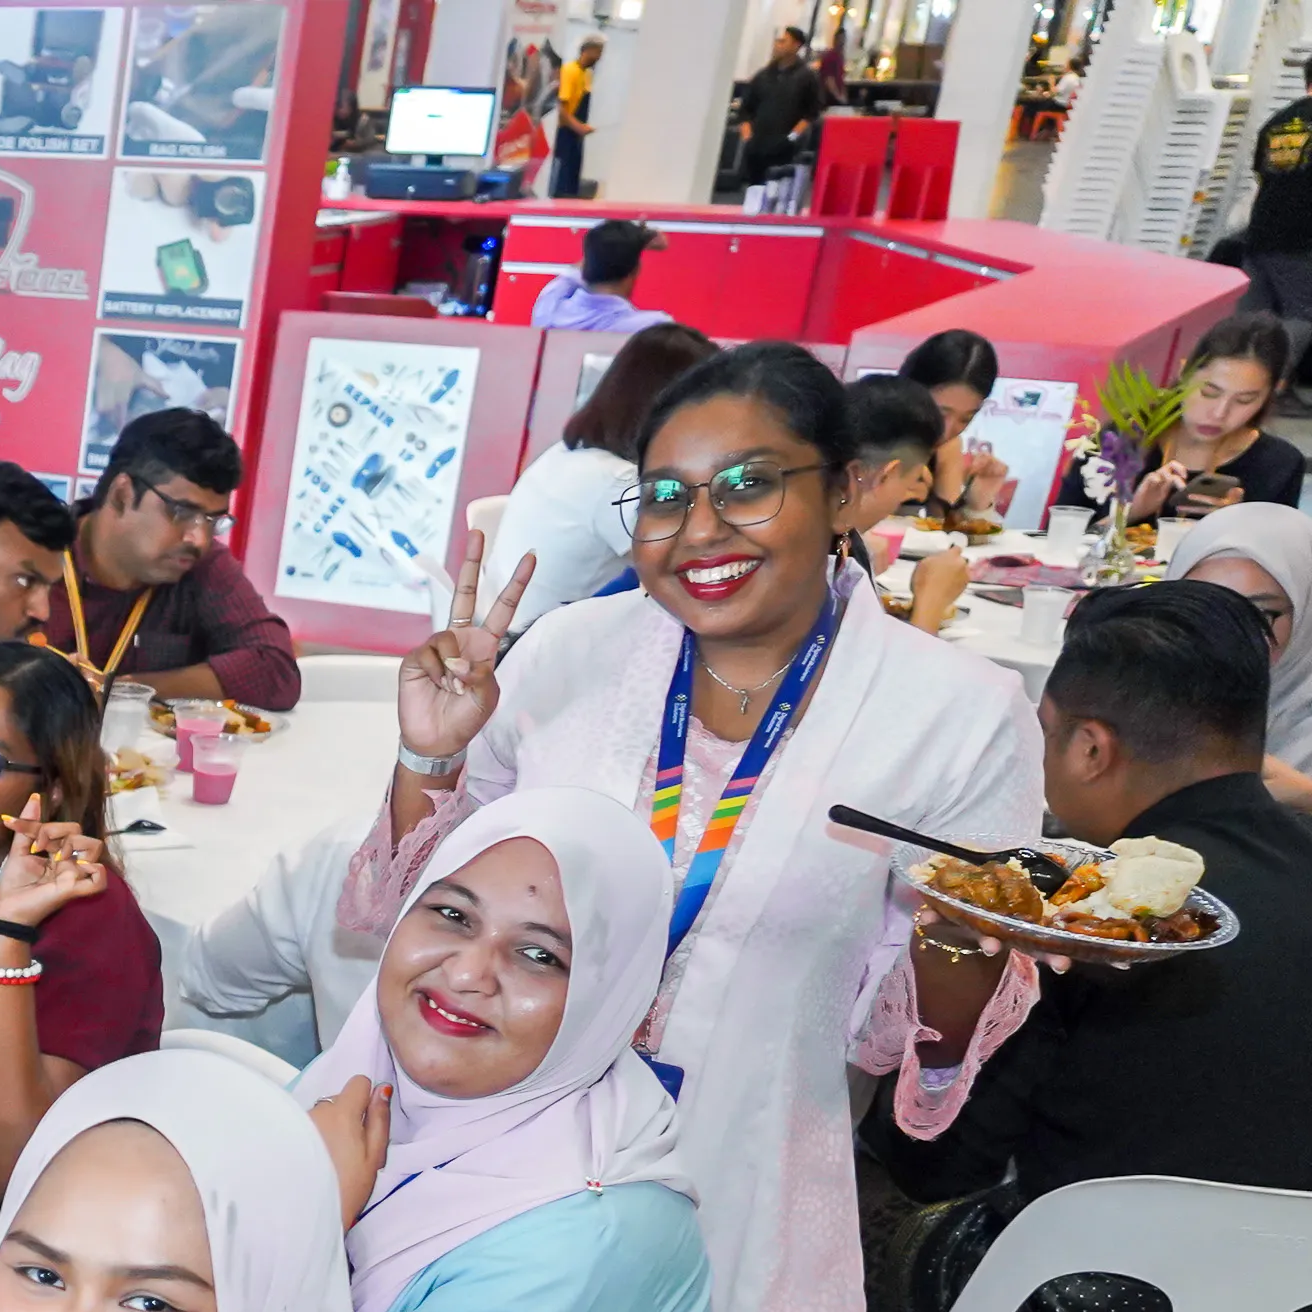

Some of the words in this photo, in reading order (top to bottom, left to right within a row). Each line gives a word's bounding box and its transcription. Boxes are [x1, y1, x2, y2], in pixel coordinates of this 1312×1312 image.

[17, 136, 69, 151] POLISH
[71, 138, 100, 152] SET
[178, 144, 226, 157] POLISH
[104, 300, 153, 314] BATTERY
[155, 304, 240, 321] REPLACEMENT
